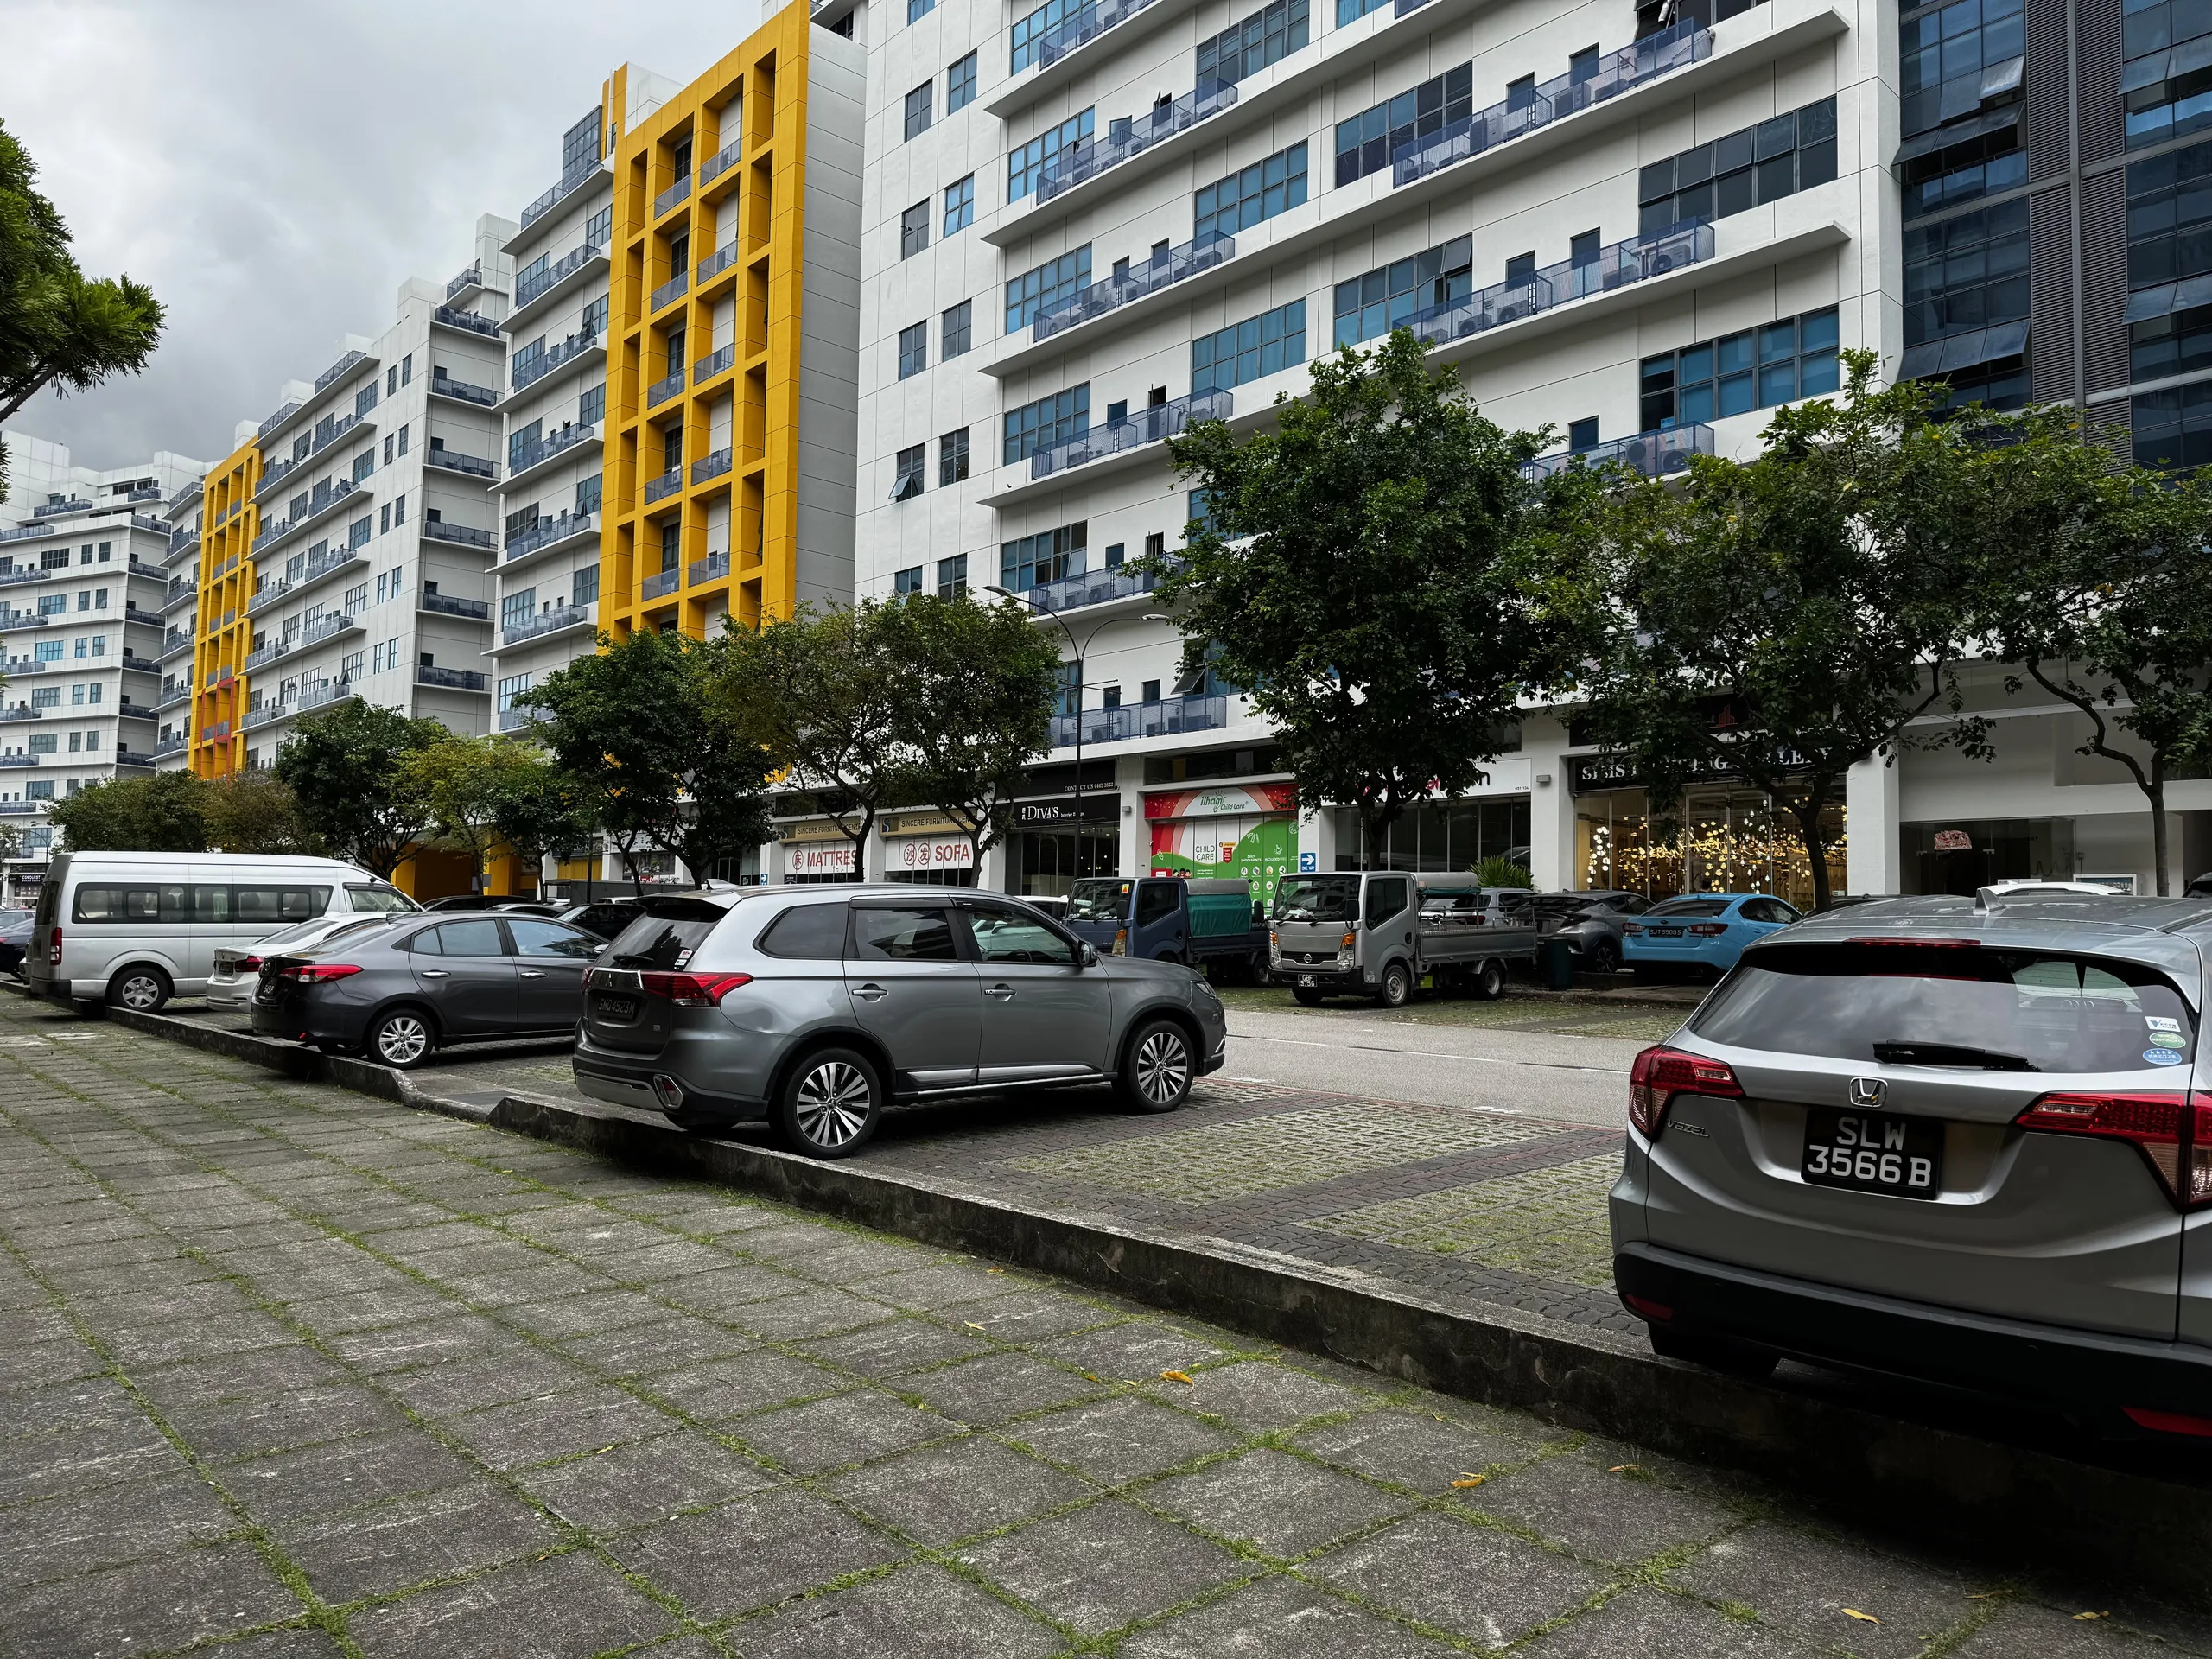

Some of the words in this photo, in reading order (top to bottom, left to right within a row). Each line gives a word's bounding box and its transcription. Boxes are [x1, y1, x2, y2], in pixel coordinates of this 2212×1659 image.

[1065, 783, 1087, 791] CONTCT
[1200, 796, 1223, 805] ilham
[901, 818, 925, 828] SINCERE
[925, 817, 957, 827] FURNITUR
[798, 826, 817, 835] SINCERE
[906, 847, 929, 861] 沙发
[935, 843, 970, 862] SOFA
[1195, 845, 1215, 854] CHILD
[807, 849, 856, 868] MATTRES
[1668, 1118, 1709, 1137] VEZEL
[1836, 1116, 1906, 1151] SLW
[1808, 1144, 1902, 1184] 3566
